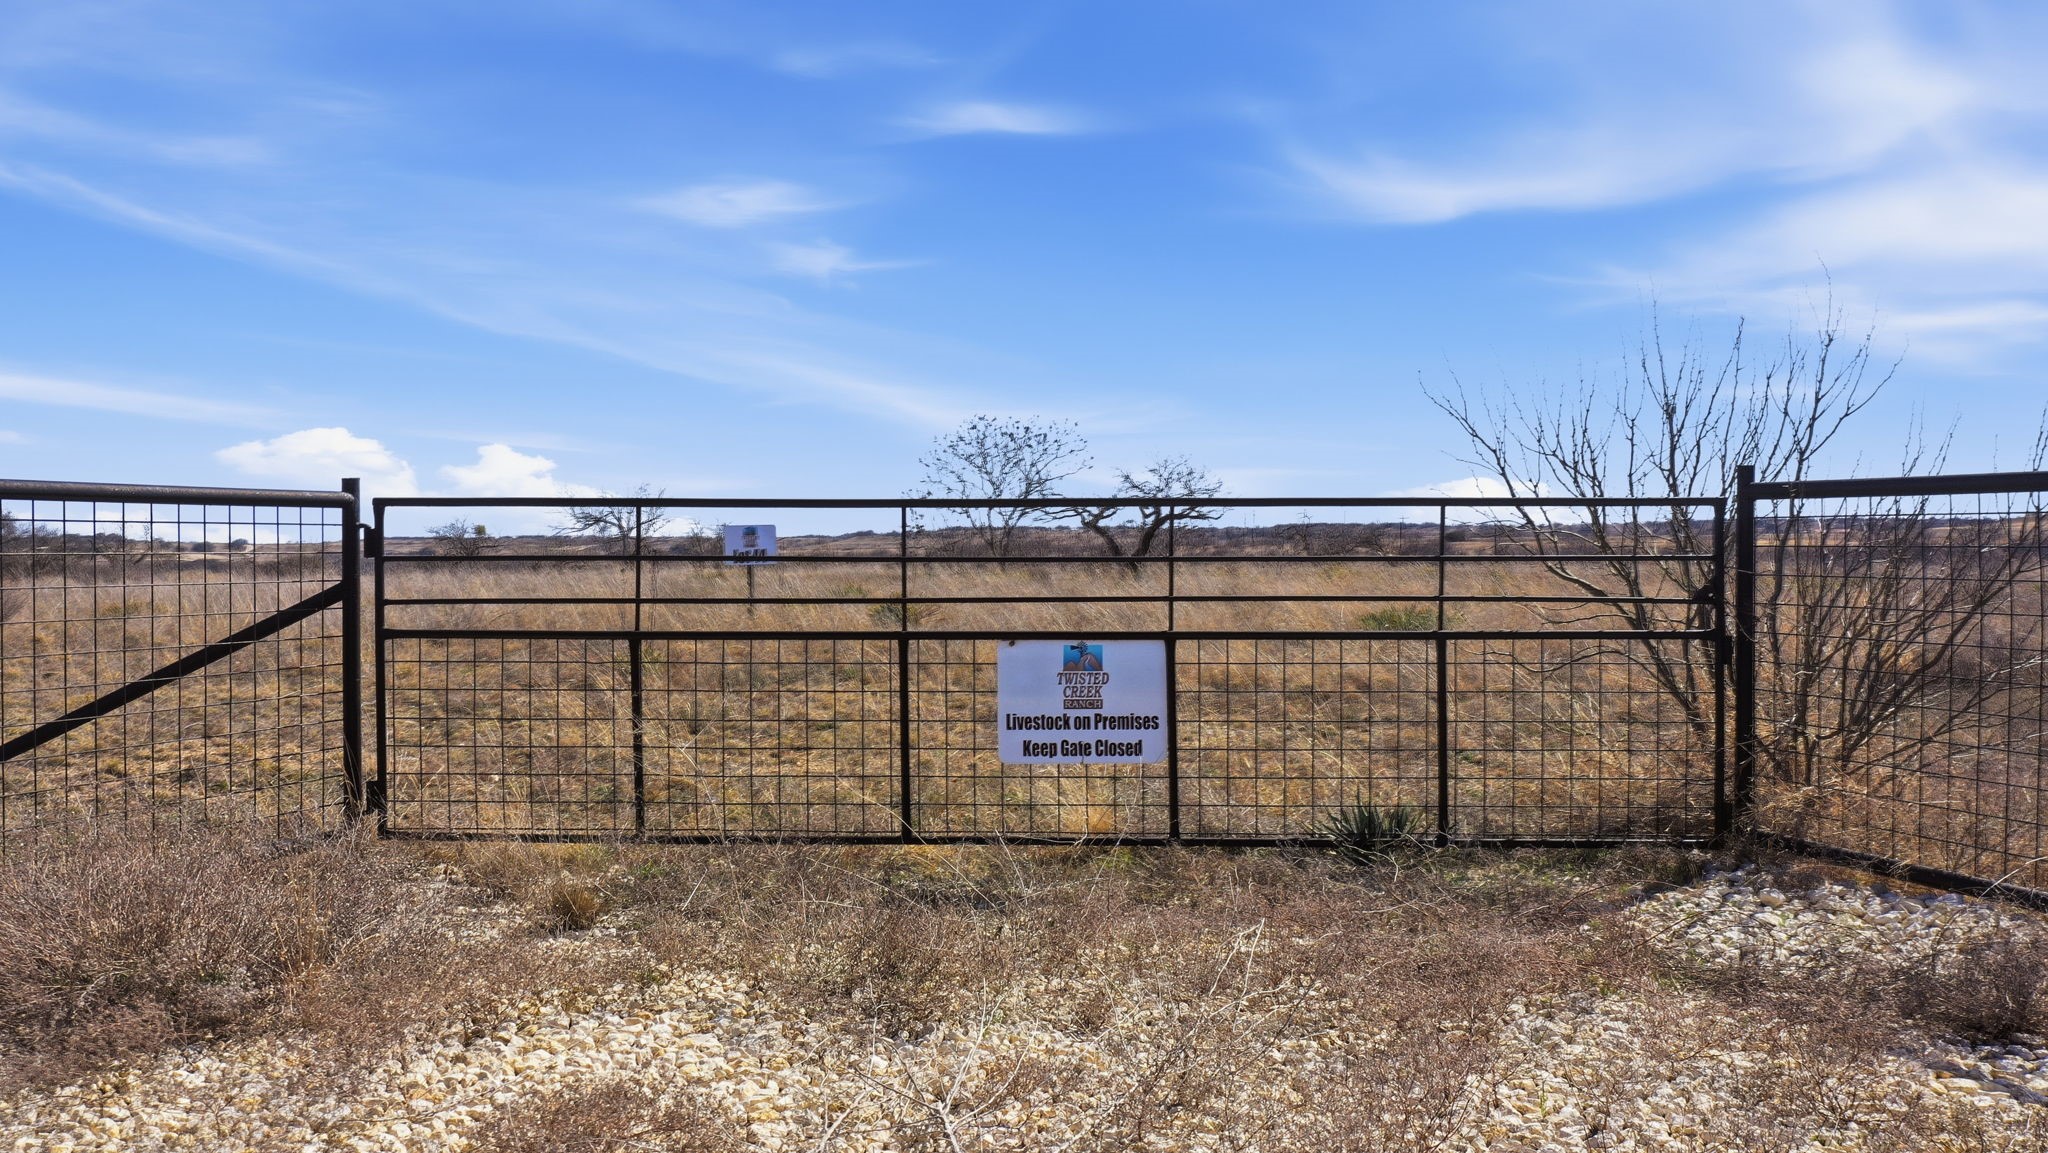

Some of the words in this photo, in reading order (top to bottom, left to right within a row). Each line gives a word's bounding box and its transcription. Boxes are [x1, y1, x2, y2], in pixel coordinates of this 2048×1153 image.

[1056, 672, 1109, 685] TWISTED
[1063, 685, 1102, 698] CREEK
[1064, 700, 1102, 709] RANCH
[1006, 713, 1071, 730] Livestock
[1074, 716, 1091, 730] on
[1094, 713, 1159, 730] Premises
[1023, 739, 1057, 758] Keep
[1061, 739, 1092, 757] Gate
[1095, 739, 1143, 757] Closed
